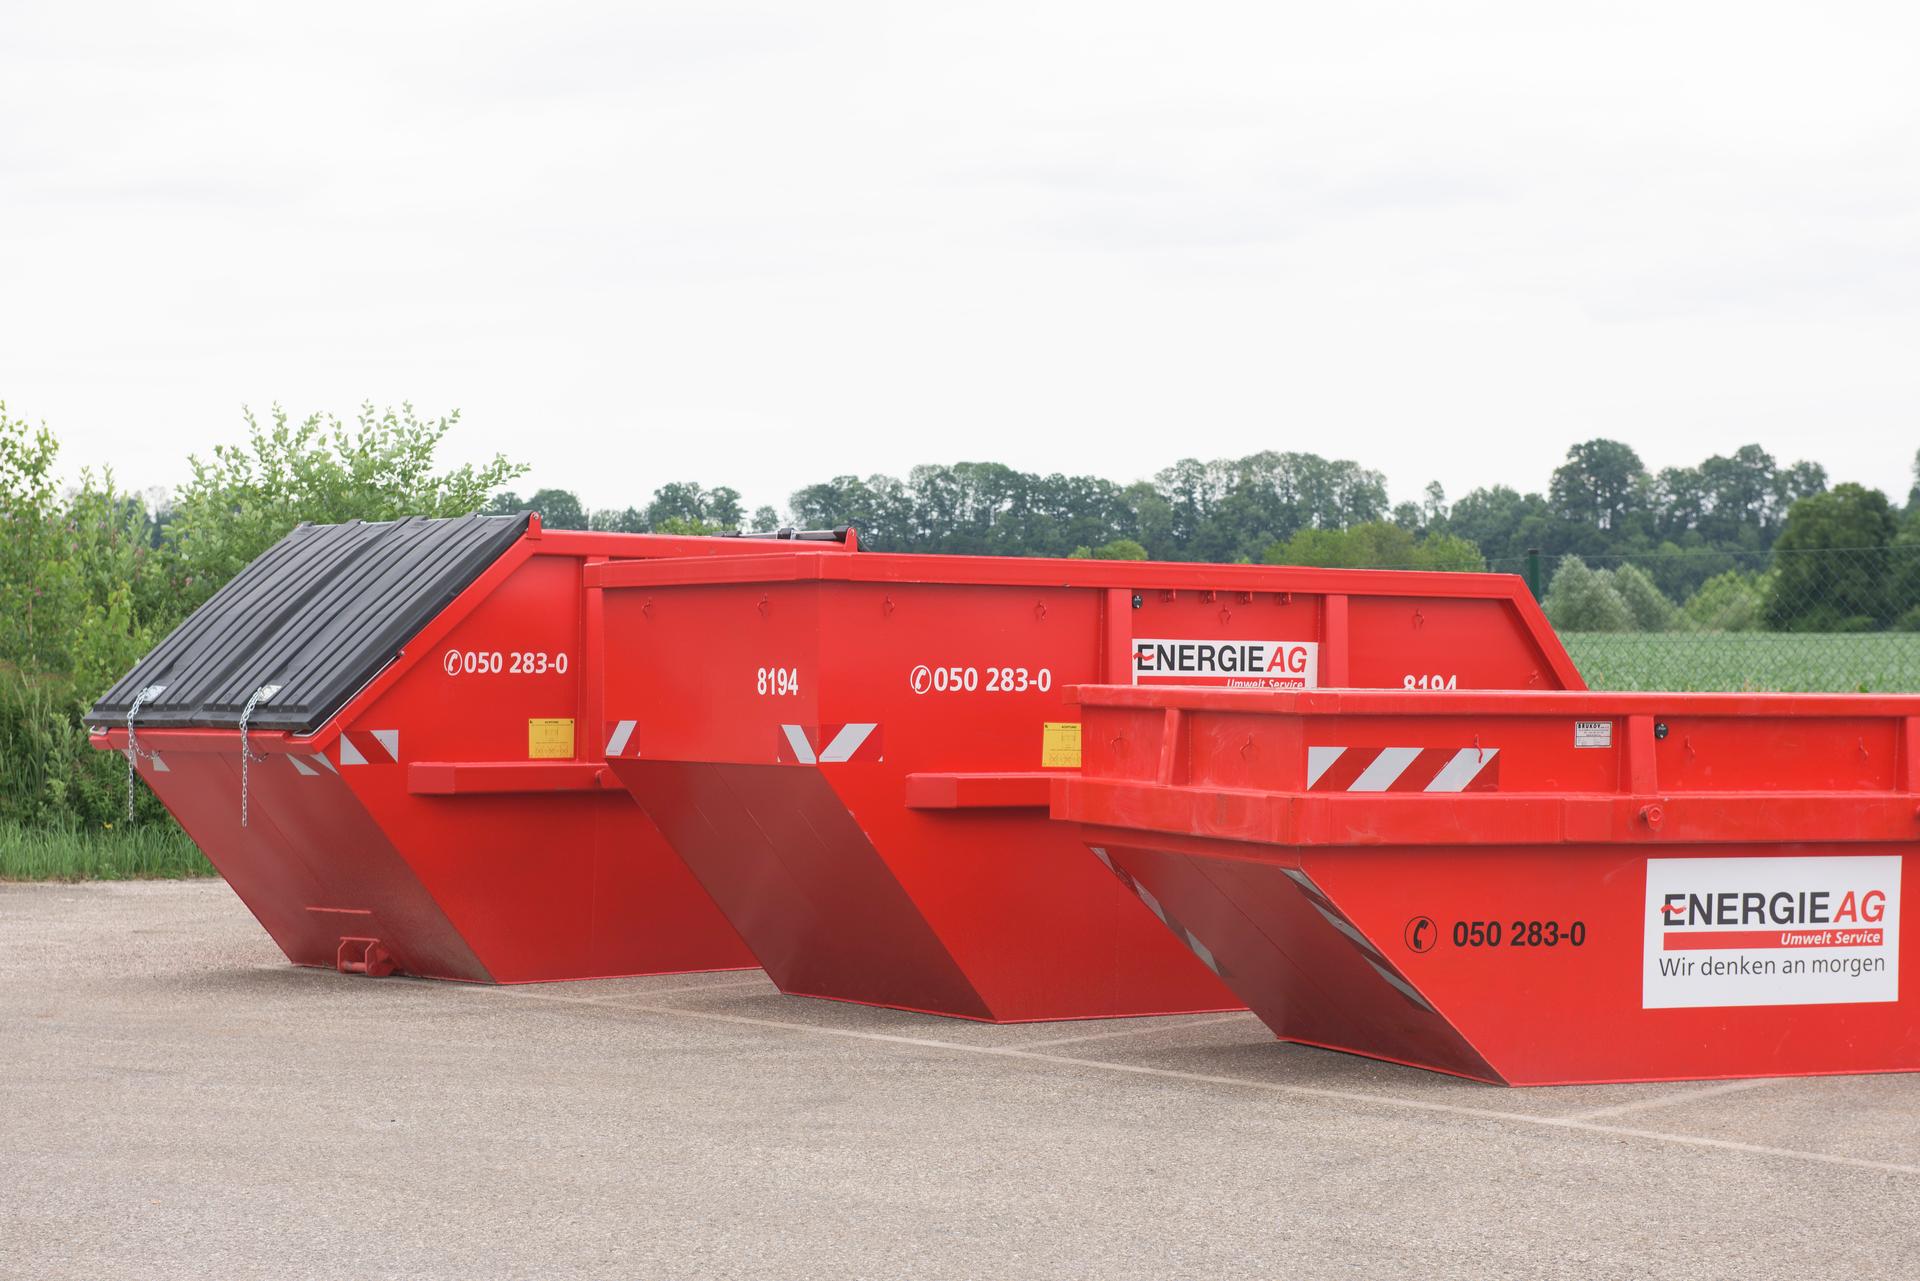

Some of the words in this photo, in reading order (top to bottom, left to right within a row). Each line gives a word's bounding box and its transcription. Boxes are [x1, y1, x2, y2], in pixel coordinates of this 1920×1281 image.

[464, 651, 503, 674] 050
[509, 652, 568, 674] 283-0
[757, 667, 799, 696] 8194
[933, 667, 979, 692] 050
[985, 667, 1051, 693] 283-0
[1453, 920, 1502, 947] 050
[1510, 920, 1586, 947] 283-0
[1781, 931, 1832, 946] Umwelt
[1834, 930, 1881, 945] Service
[1659, 957, 1696, 977] Wir
[1701, 955, 1776, 977] denken
[1782, 959, 1805, 974] an
[1812, 956, 1886, 977] morgen
